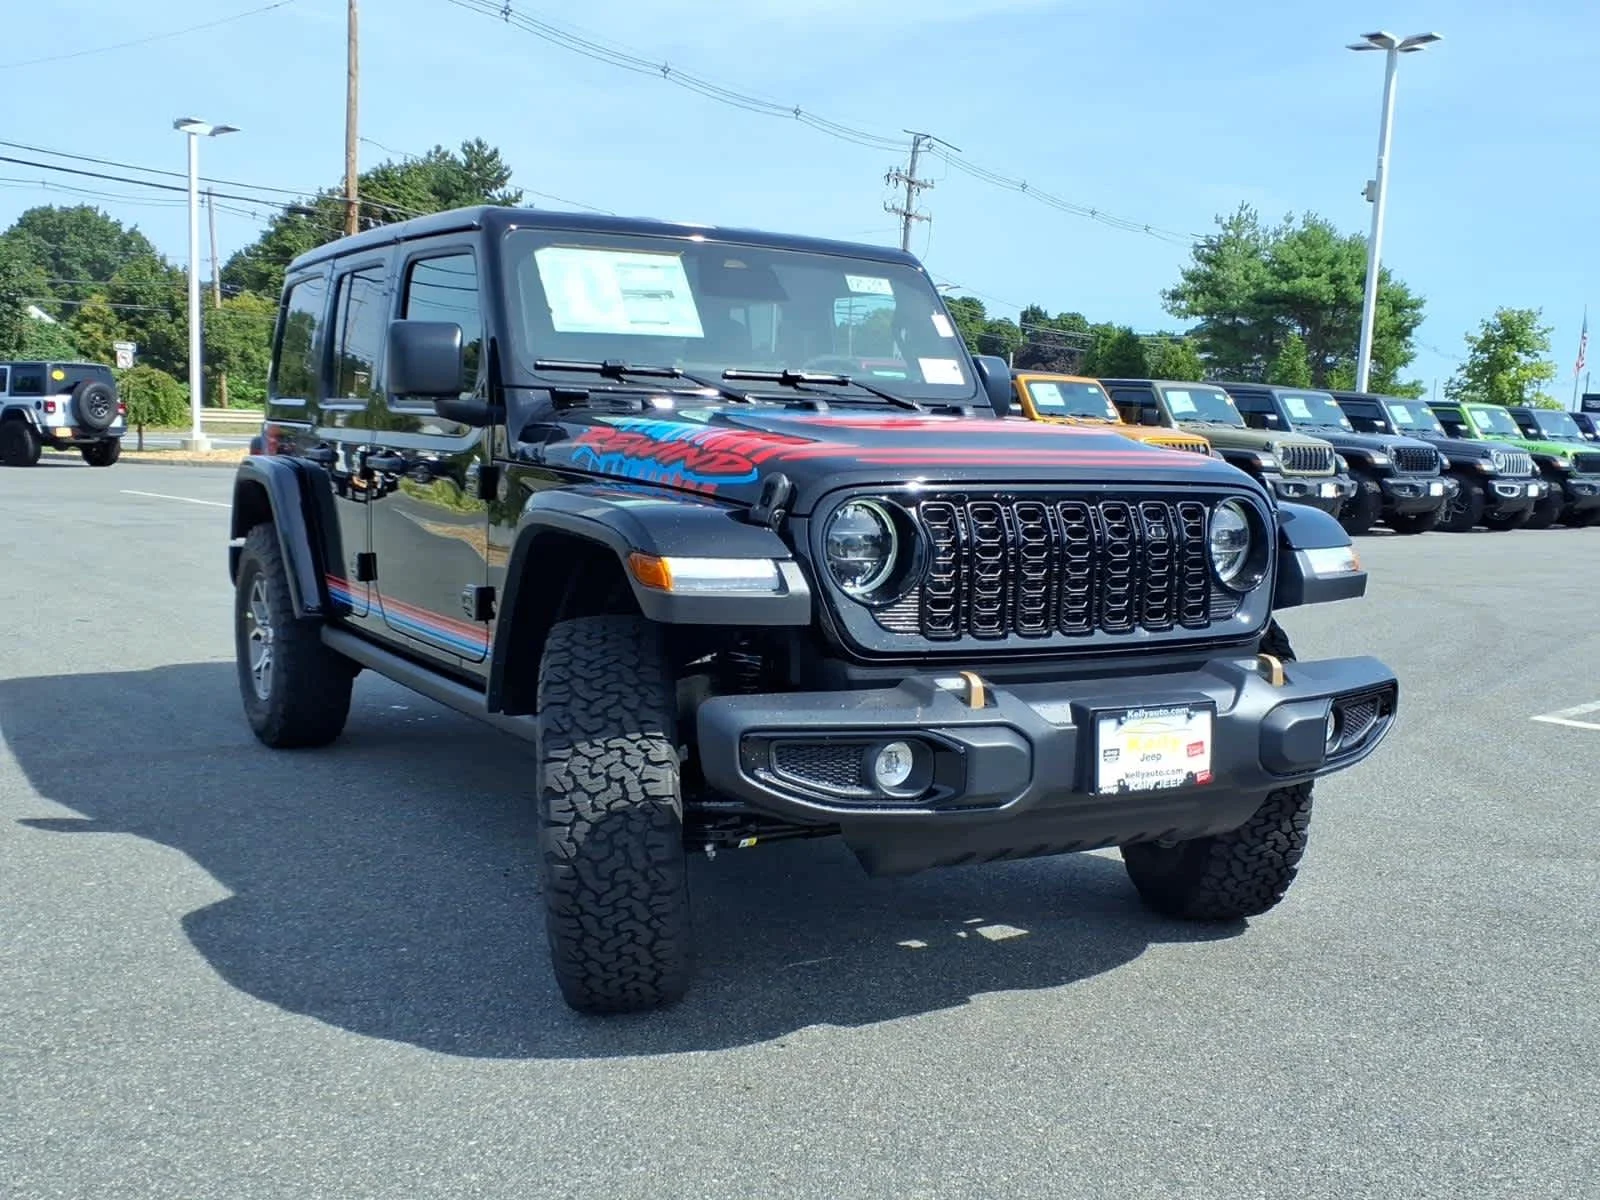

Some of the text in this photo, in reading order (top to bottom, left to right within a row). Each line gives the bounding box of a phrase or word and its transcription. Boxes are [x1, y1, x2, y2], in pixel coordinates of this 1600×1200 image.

[576, 426, 753, 473] REWIND
[1140, 752, 1162, 762] Jeep
[1157, 778, 1184, 788] JEEP
